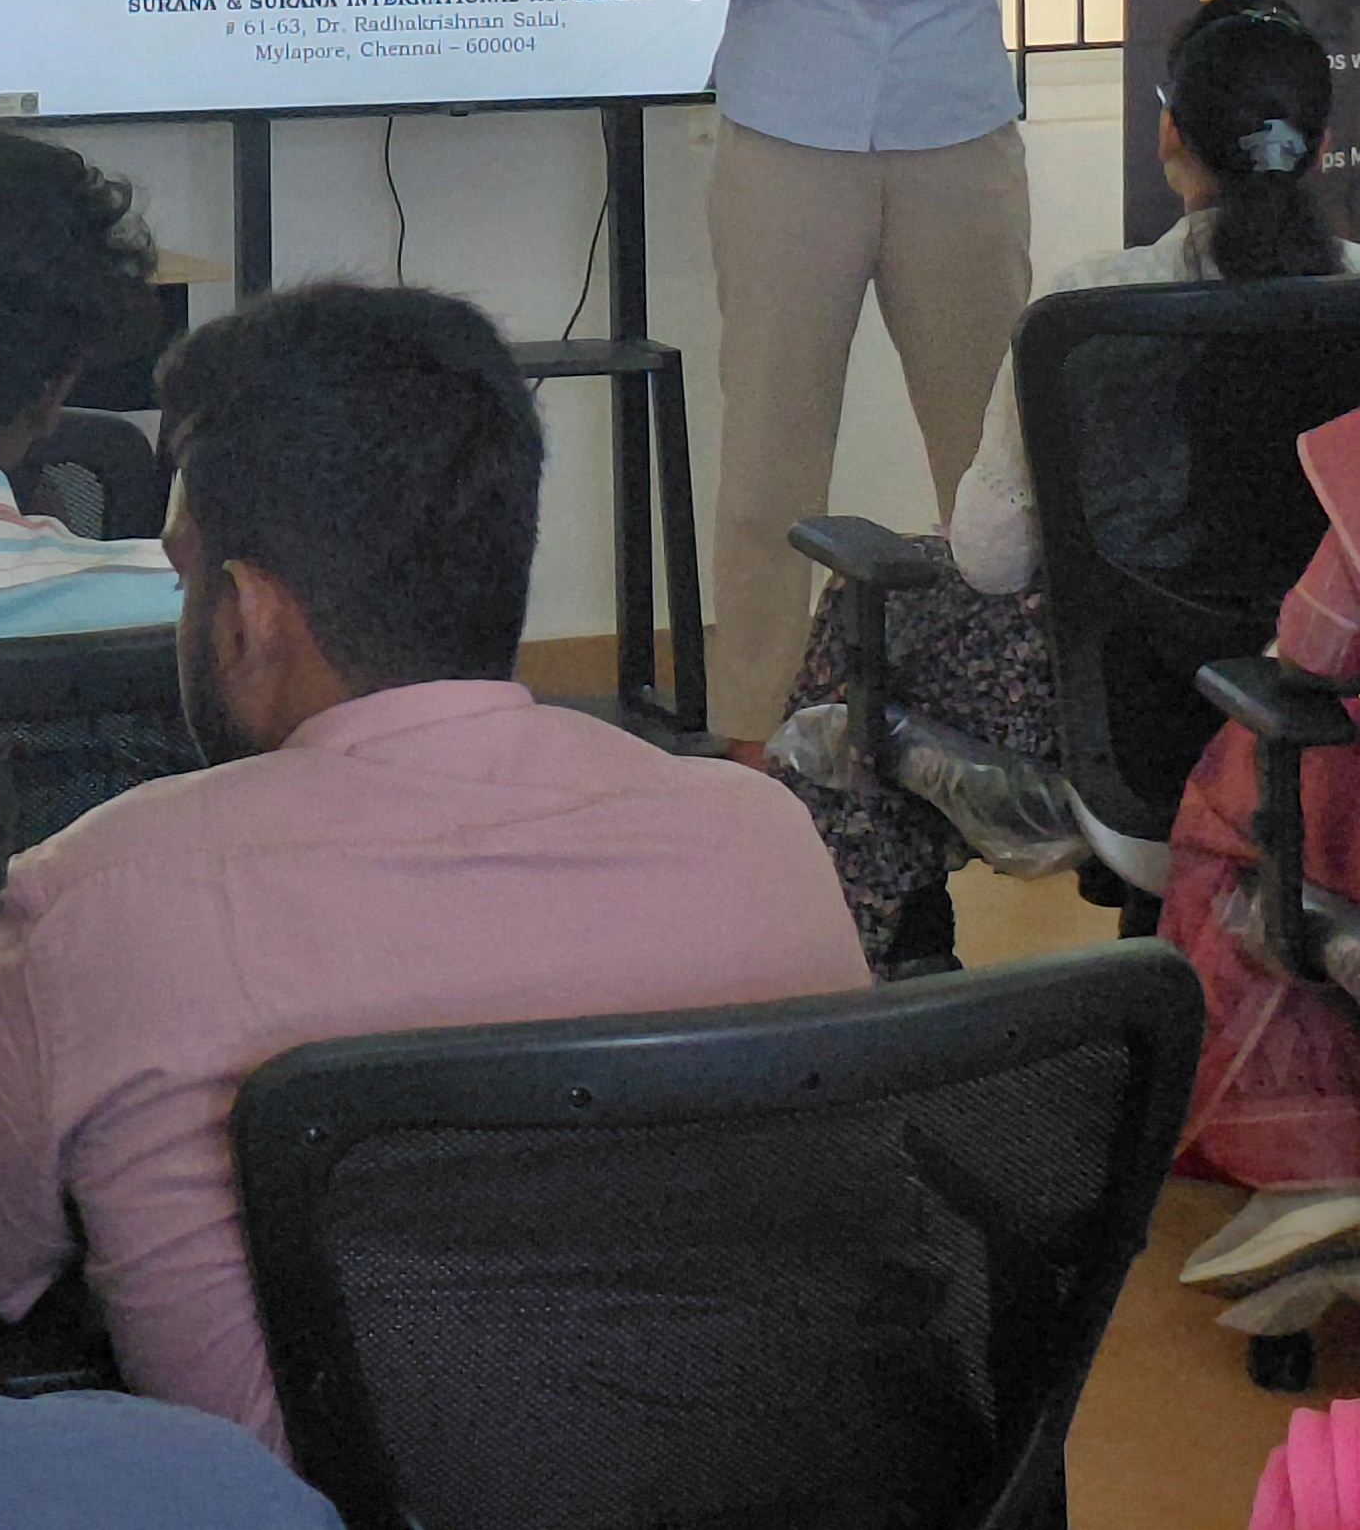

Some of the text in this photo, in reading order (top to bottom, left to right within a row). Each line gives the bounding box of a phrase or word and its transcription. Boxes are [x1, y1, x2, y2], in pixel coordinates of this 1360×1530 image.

[243, 19, 307, 37] 61-63,
[355, 12, 504, 32] Radhakrishnan
[255, 42, 351, 65] Mylapore,
[360, 39, 442, 58] Chennai
[466, 36, 536, 54] 600004
